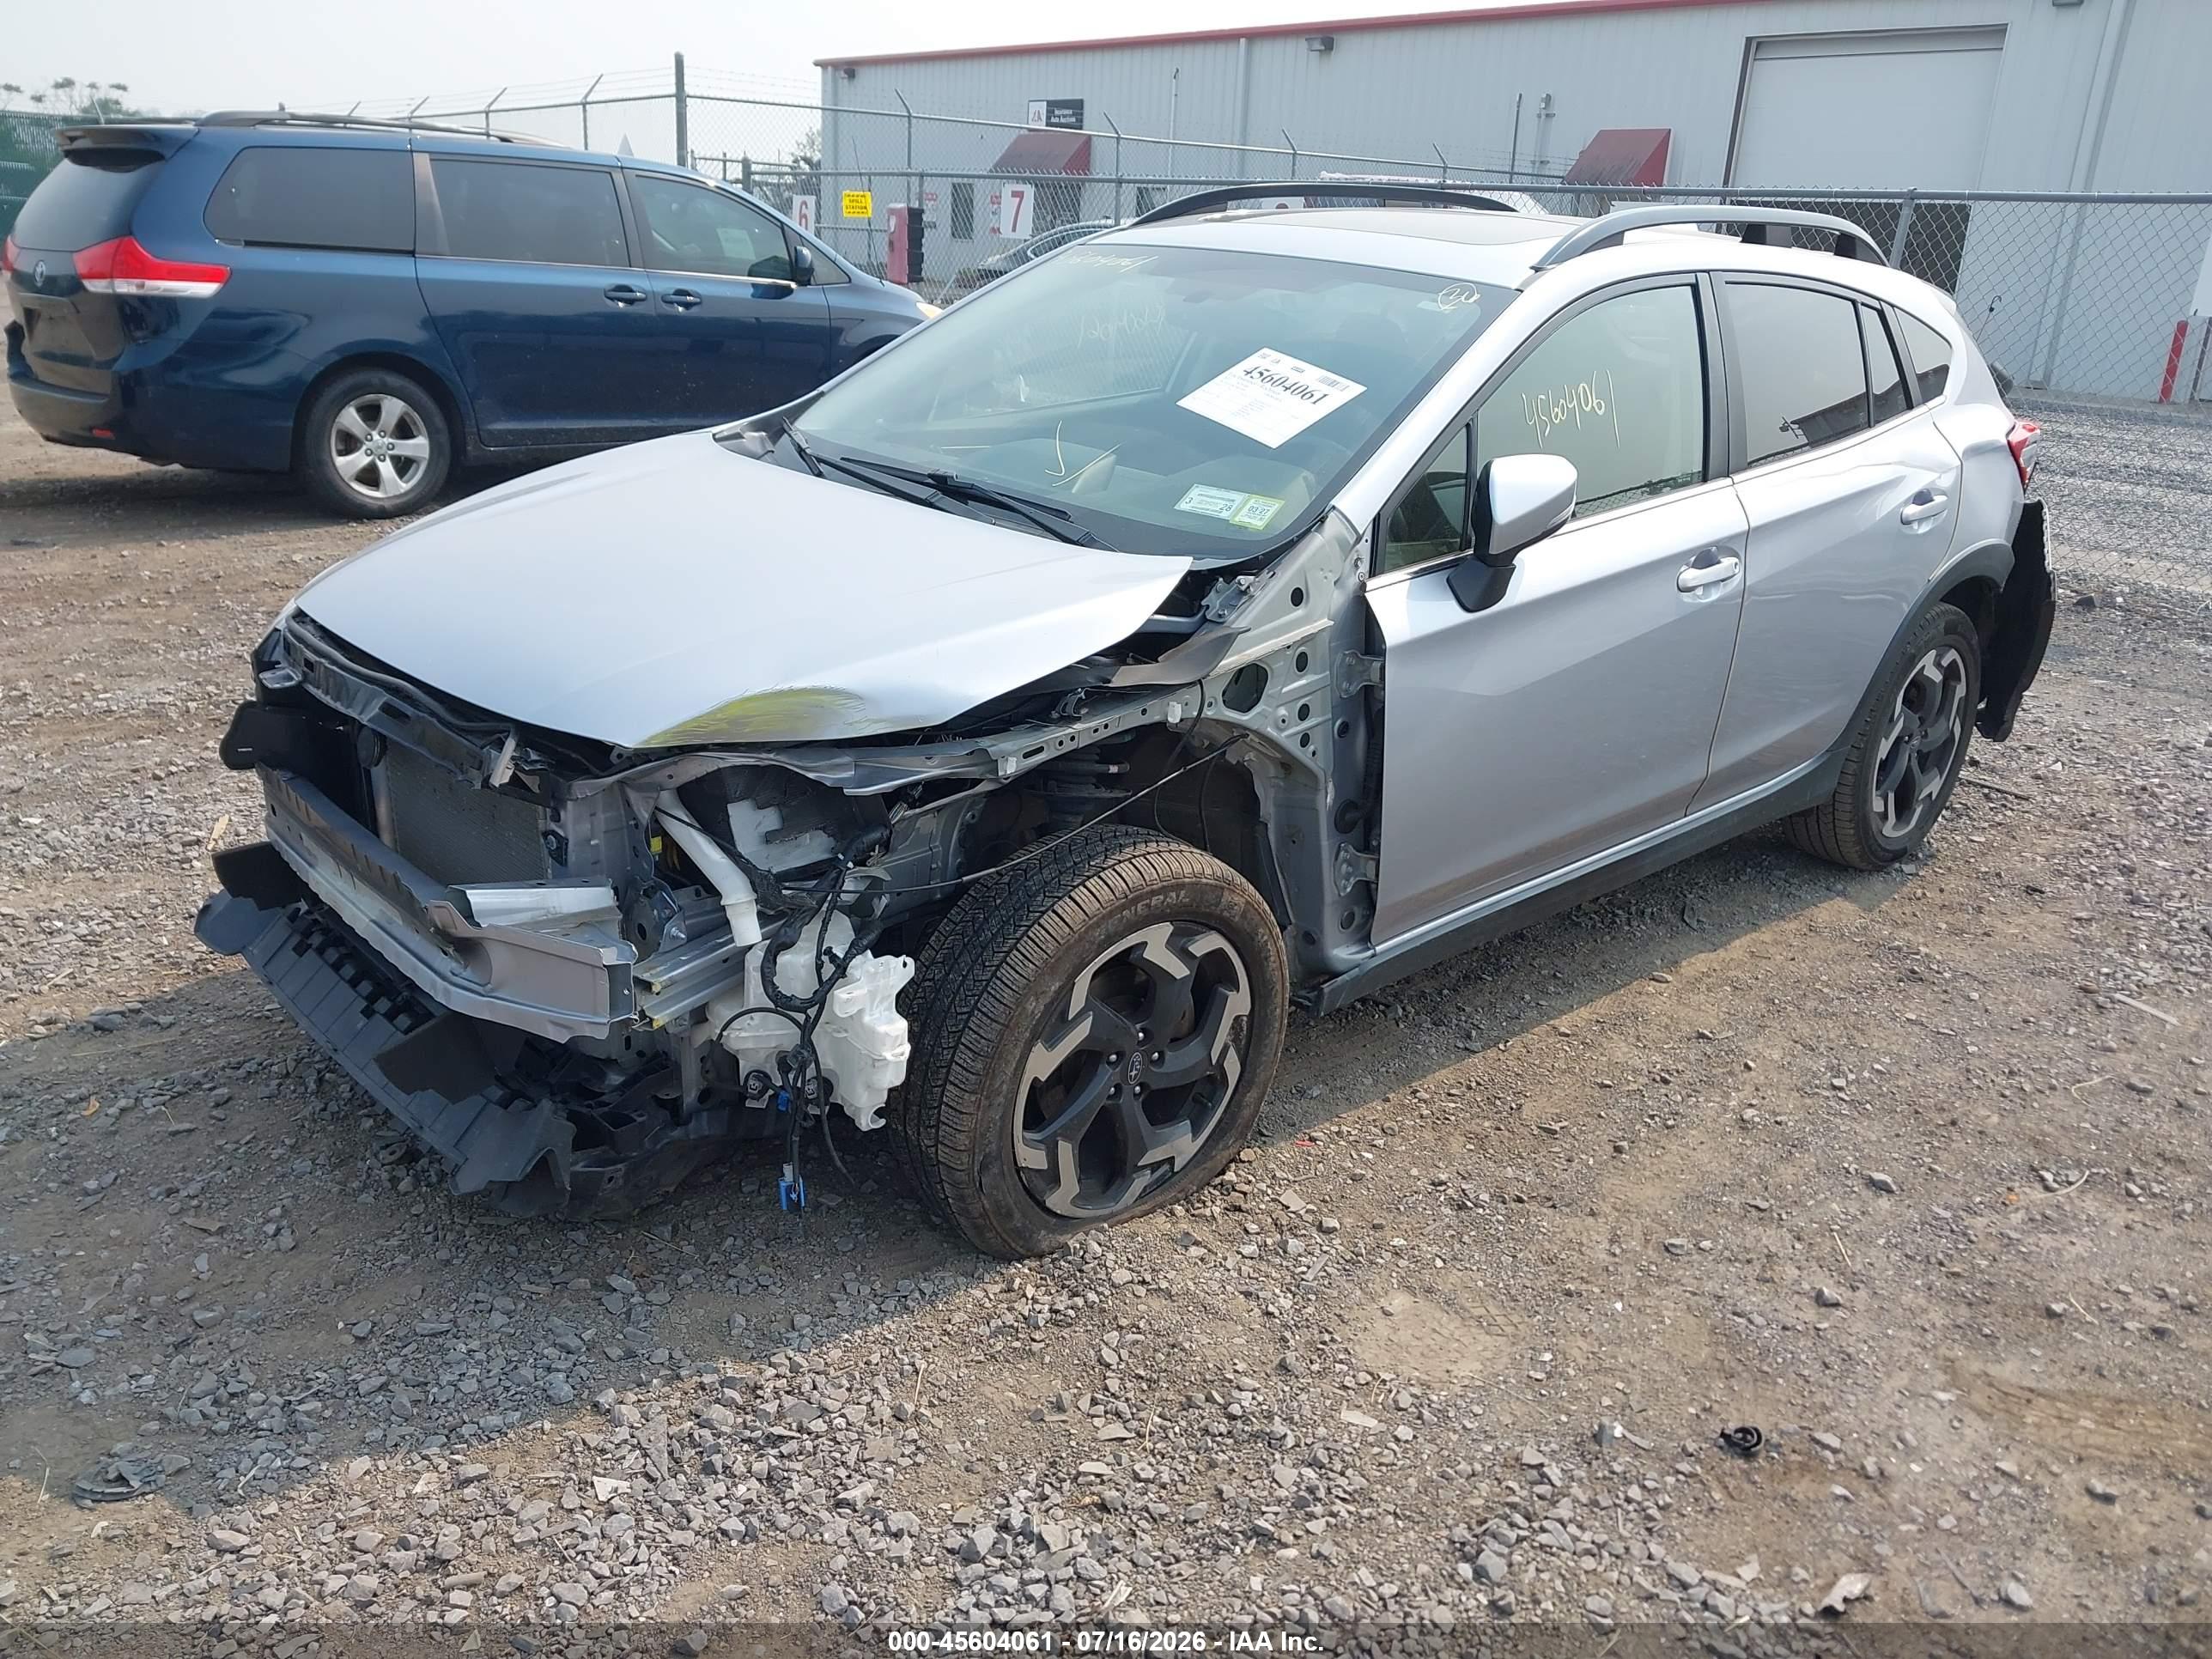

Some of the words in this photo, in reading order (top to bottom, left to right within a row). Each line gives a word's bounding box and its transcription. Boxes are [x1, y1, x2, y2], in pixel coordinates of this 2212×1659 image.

[1010, 190, 1024, 233] 7
[1243, 365, 1330, 405] 45604061
[1521, 369, 1620, 449] 45604061
[1218, 503, 1234, 512] 28
